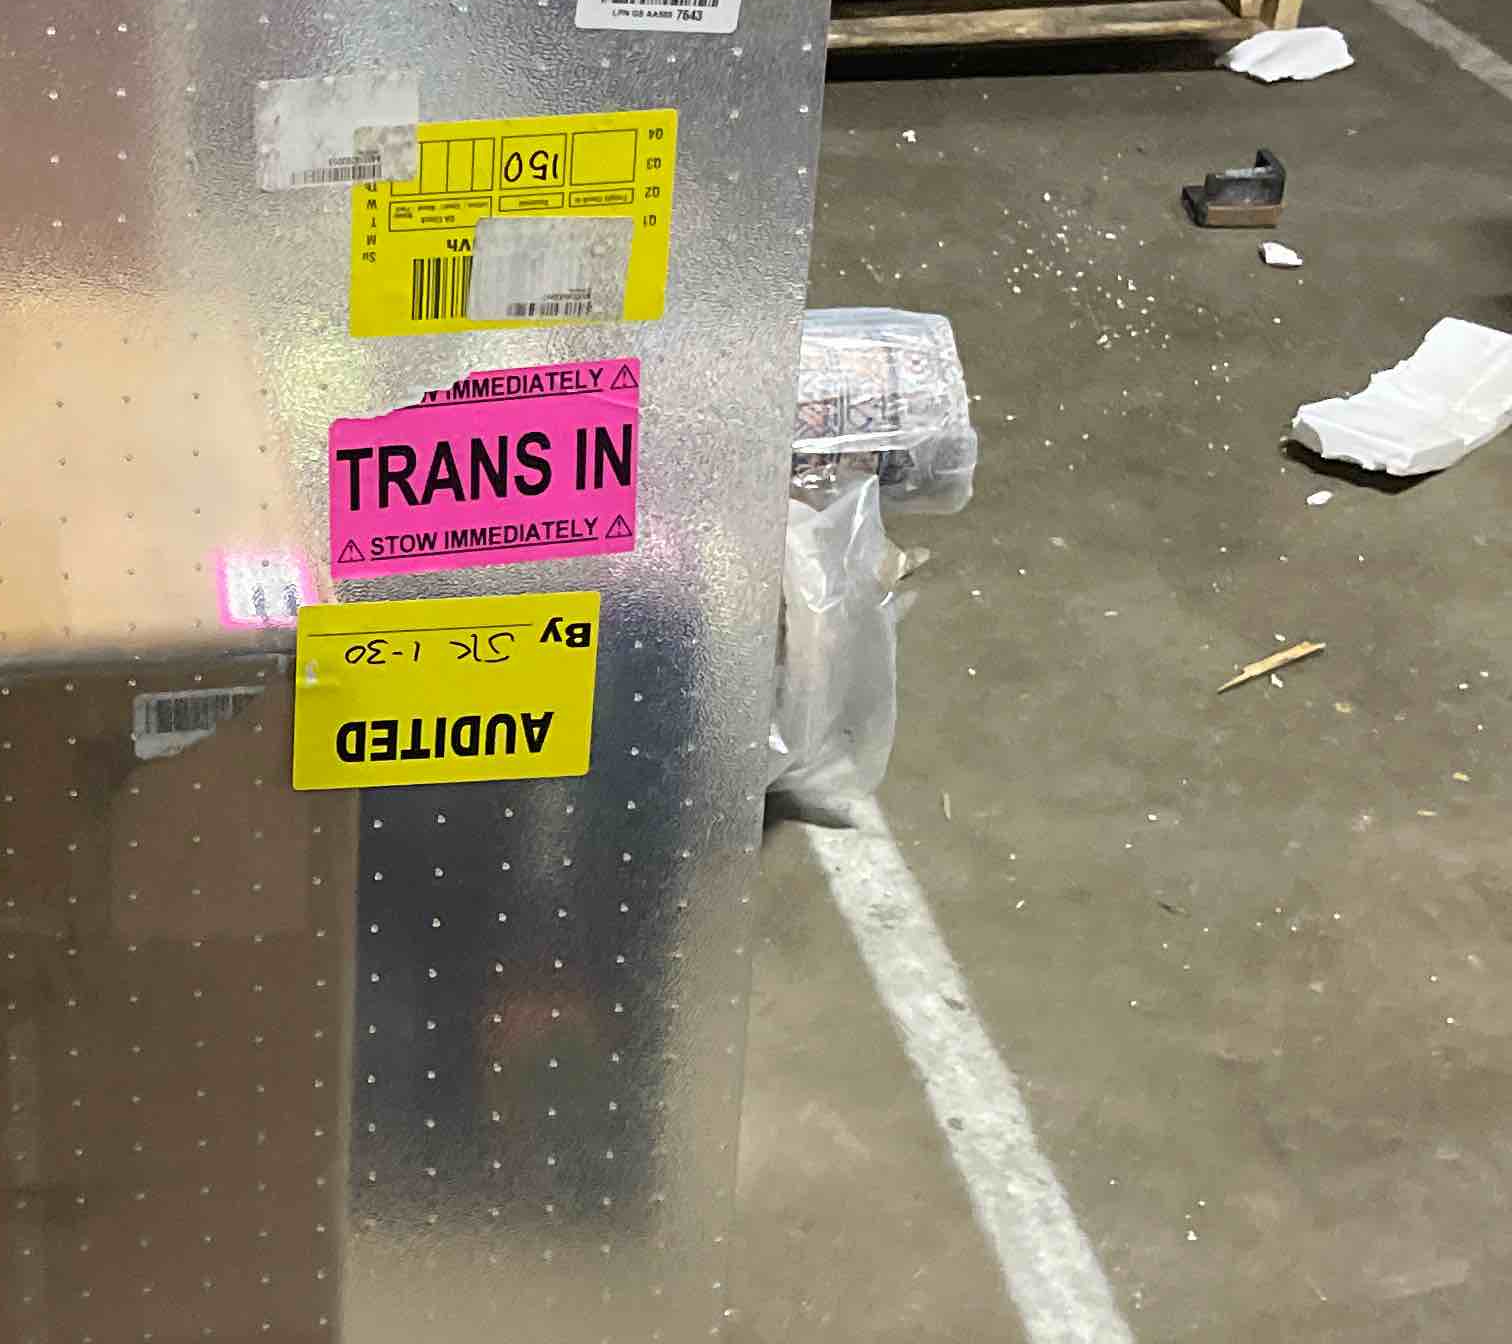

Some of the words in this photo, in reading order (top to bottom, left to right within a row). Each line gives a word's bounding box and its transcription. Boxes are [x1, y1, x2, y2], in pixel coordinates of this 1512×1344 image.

[676, 9, 704, 22] 7643
[647, 127, 664, 141] Q4
[503, 149, 559, 183] 150
[645, 157, 662, 170] Q3
[643, 186, 661, 199] Q2
[366, 199, 378, 209] W
[642, 214, 657, 227] Q1
[366, 235, 377, 246] M
[446, 237, 473, 253] Vh
[361, 250, 377, 263] Su
[335, 430, 553, 512] TRANS
[574, 423, 634, 491] IN
[370, 531, 438, 557] STOW
[443, 516, 599, 551] IMMEDIATELY
[539, 616, 592, 649] By
[343, 638, 422, 665] 1-30
[335, 711, 556, 764] AUDITED
